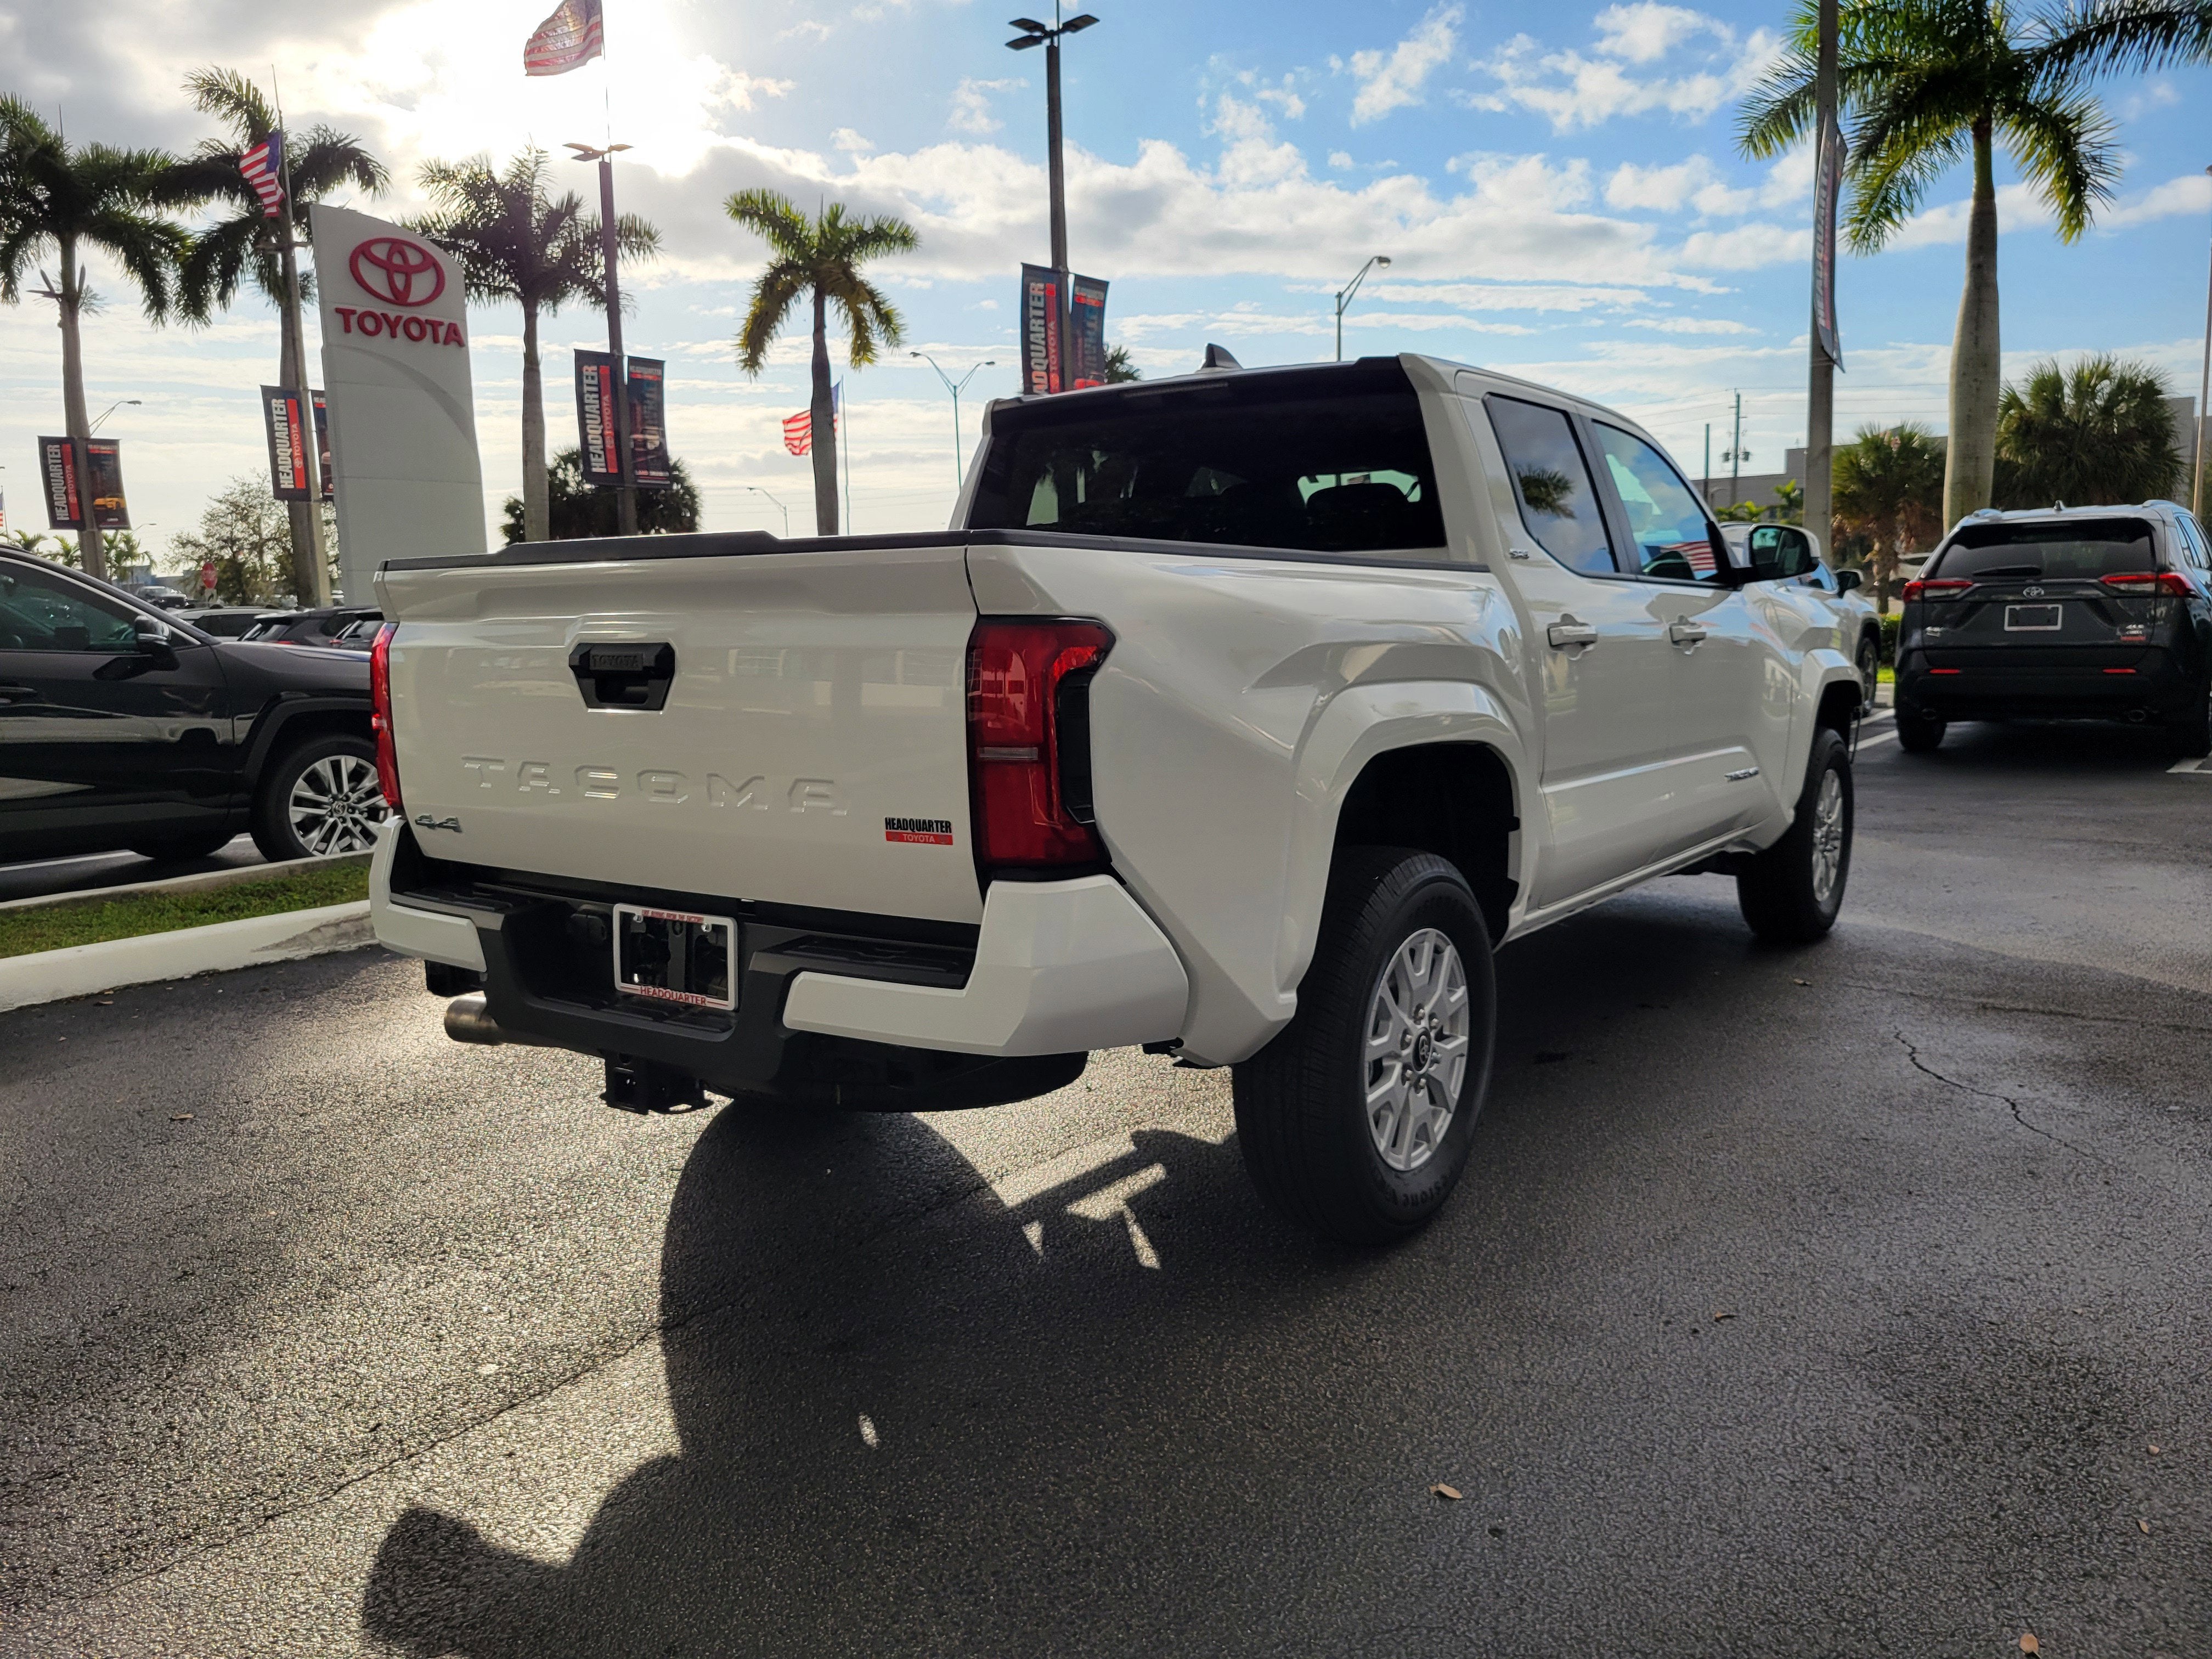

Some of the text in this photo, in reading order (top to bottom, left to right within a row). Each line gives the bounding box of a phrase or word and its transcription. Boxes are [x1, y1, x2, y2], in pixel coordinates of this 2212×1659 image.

[335, 308, 465, 347] TOYOTA
[1029, 282, 1048, 394] ADQUARTER
[583, 365, 607, 473] HEADQUARTER
[272, 398, 295, 488] HEADQUARTER
[292, 422, 302, 456] TOYOTA
[47, 444, 70, 521] HEADQUARTER
[591, 654, 639, 668] TOYOTA
[461, 755, 849, 816] TACOMA
[885, 817, 952, 833] HEADQUARTER
[902, 833, 935, 843] TOYOTA
[640, 986, 707, 1005] HEADQUARTER
